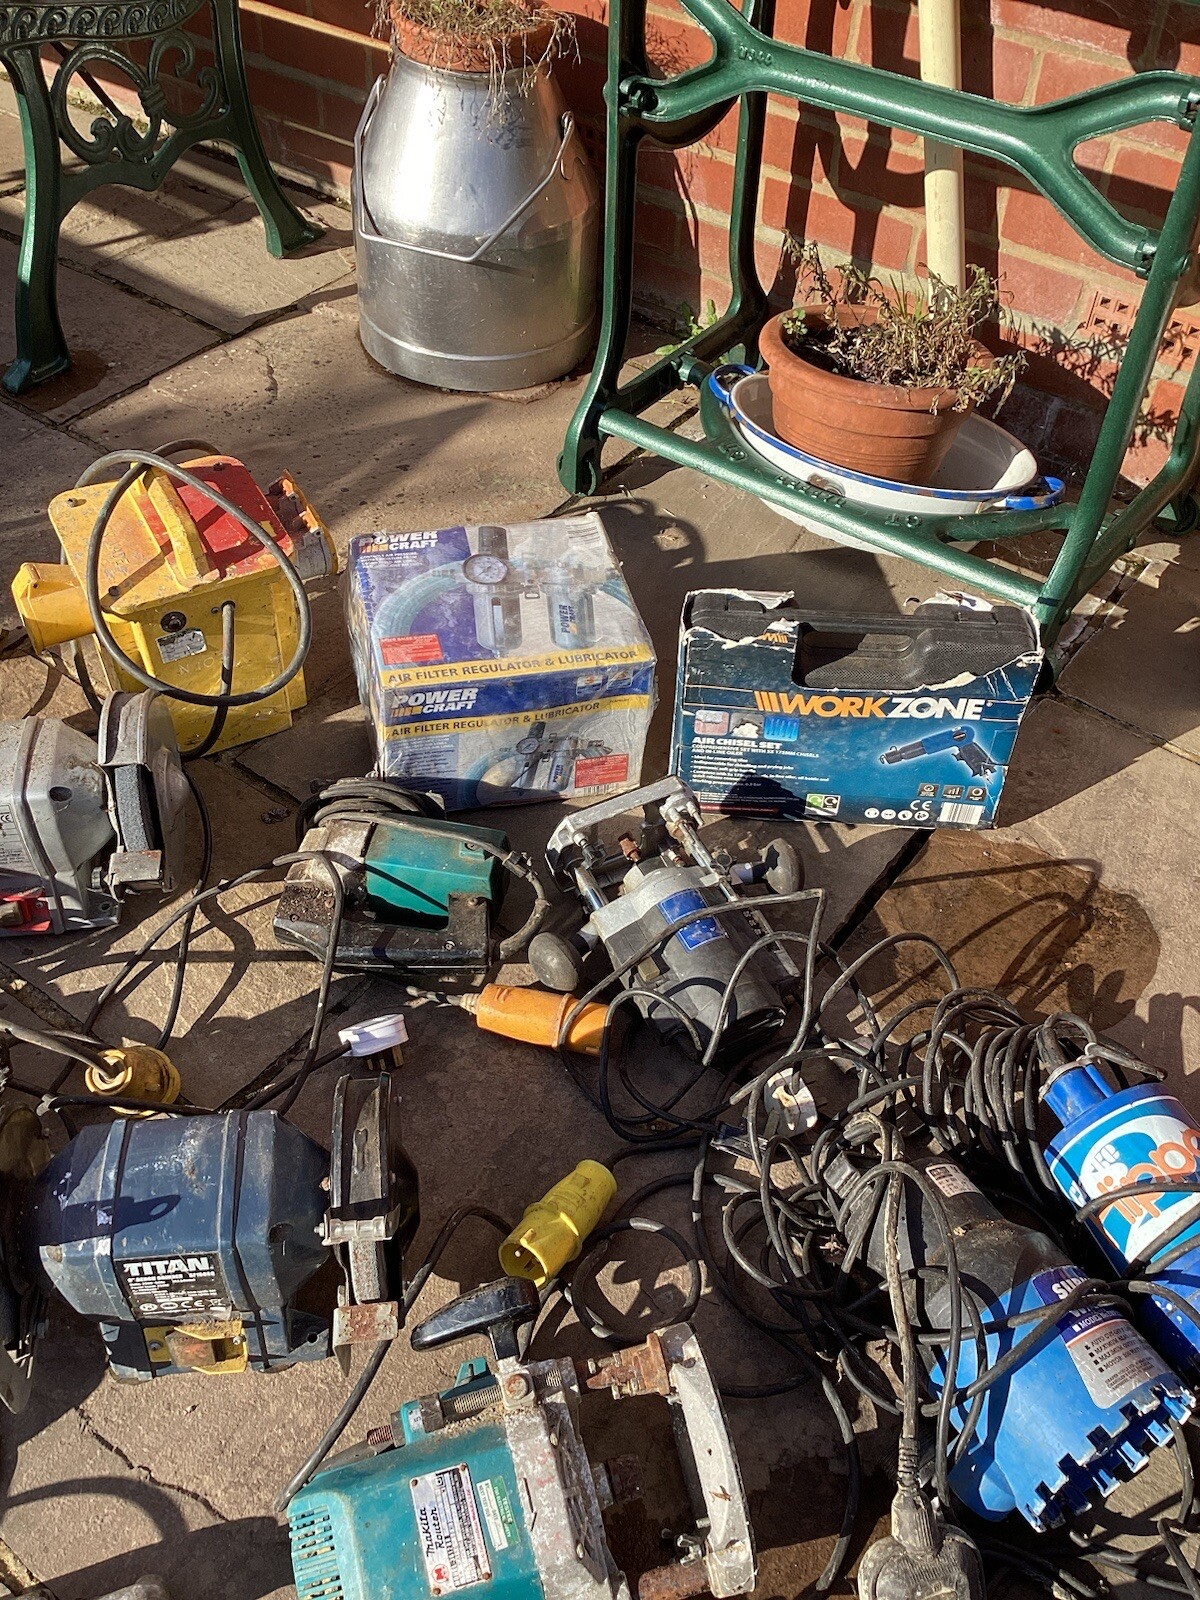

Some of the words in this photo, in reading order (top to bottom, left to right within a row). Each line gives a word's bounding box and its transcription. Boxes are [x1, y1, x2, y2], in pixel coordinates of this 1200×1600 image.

[359, 530, 438, 546] POWER
[389, 540, 438, 550] CRAFT
[388, 674, 411, 684] AIR
[416, 669, 457, 680] FILTER
[462, 658, 541, 675] REGULATOR
[545, 658, 555, 667] &
[558, 650, 638, 665] LUBRICATOR
[391, 687, 479, 709] POWER
[779, 692, 986, 720] WORKZONE
[422, 700, 477, 714] CRAFT
[392, 728, 411, 737] AIR
[414, 721, 449, 733] FILTER
[453, 716, 519, 729] REGULATOR
[523, 715, 532, 723] &
[535, 702, 600, 721] LUBRICATOR
[692, 737, 715, 745] AIR
[716, 738, 758, 748] CHISEL
[759, 741, 783, 750] SET
[692, 744, 740, 752] COMPREHENSIVE
[123, 1257, 209, 1277] TITAN
[1078, 1313, 1102, 1329] MODEL
[1091, 1336, 1104, 1347] AUTO
[1094, 1337, 1118, 1354] MAXIMUM
[1098, 1345, 1123, 1361] MAXIMUM
[420, 1507, 434, 1557] Makita
[430, 1506, 445, 1549] Router
